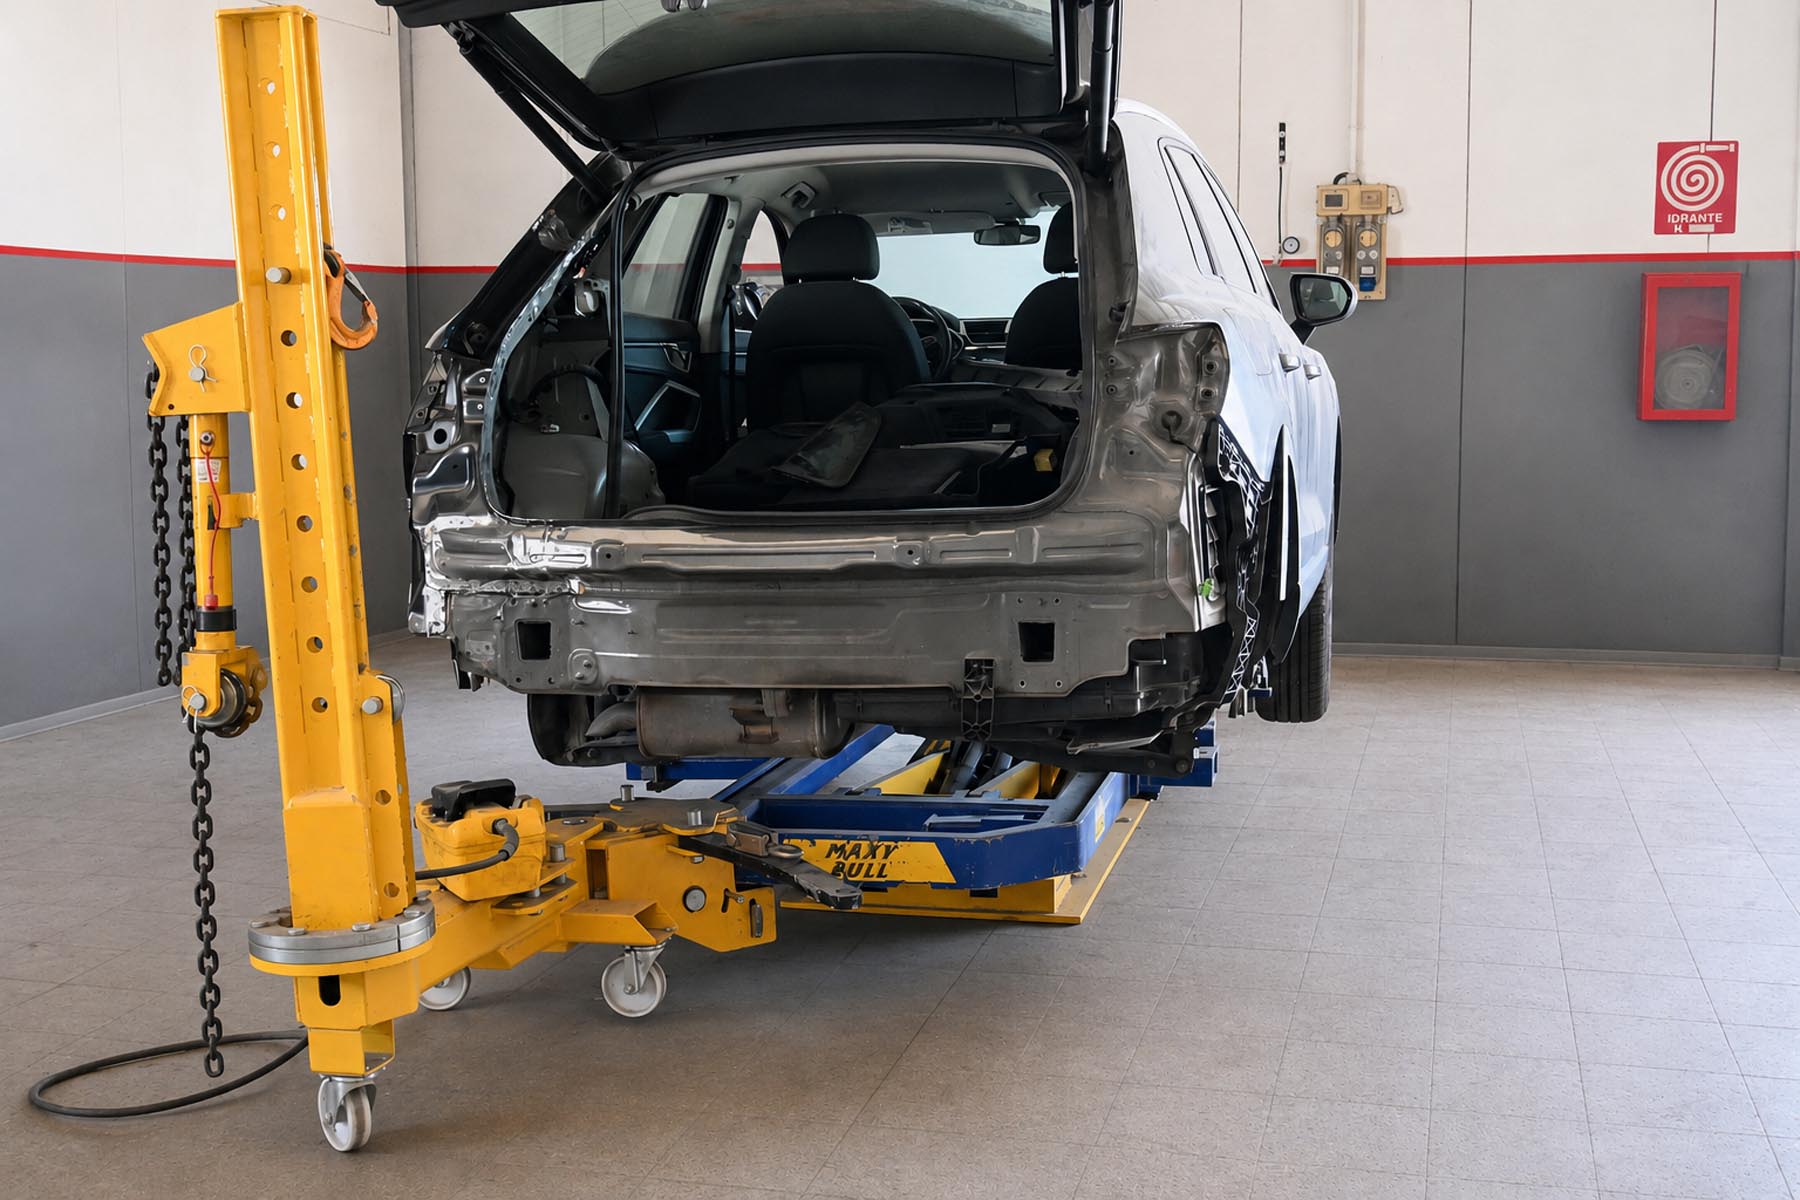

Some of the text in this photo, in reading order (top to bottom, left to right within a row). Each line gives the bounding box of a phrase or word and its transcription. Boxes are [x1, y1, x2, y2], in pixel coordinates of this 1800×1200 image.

[1667, 212, 1723, 223] IDRANTE
[825, 842, 898, 860] MAXY
[831, 861, 889, 878] BULL
